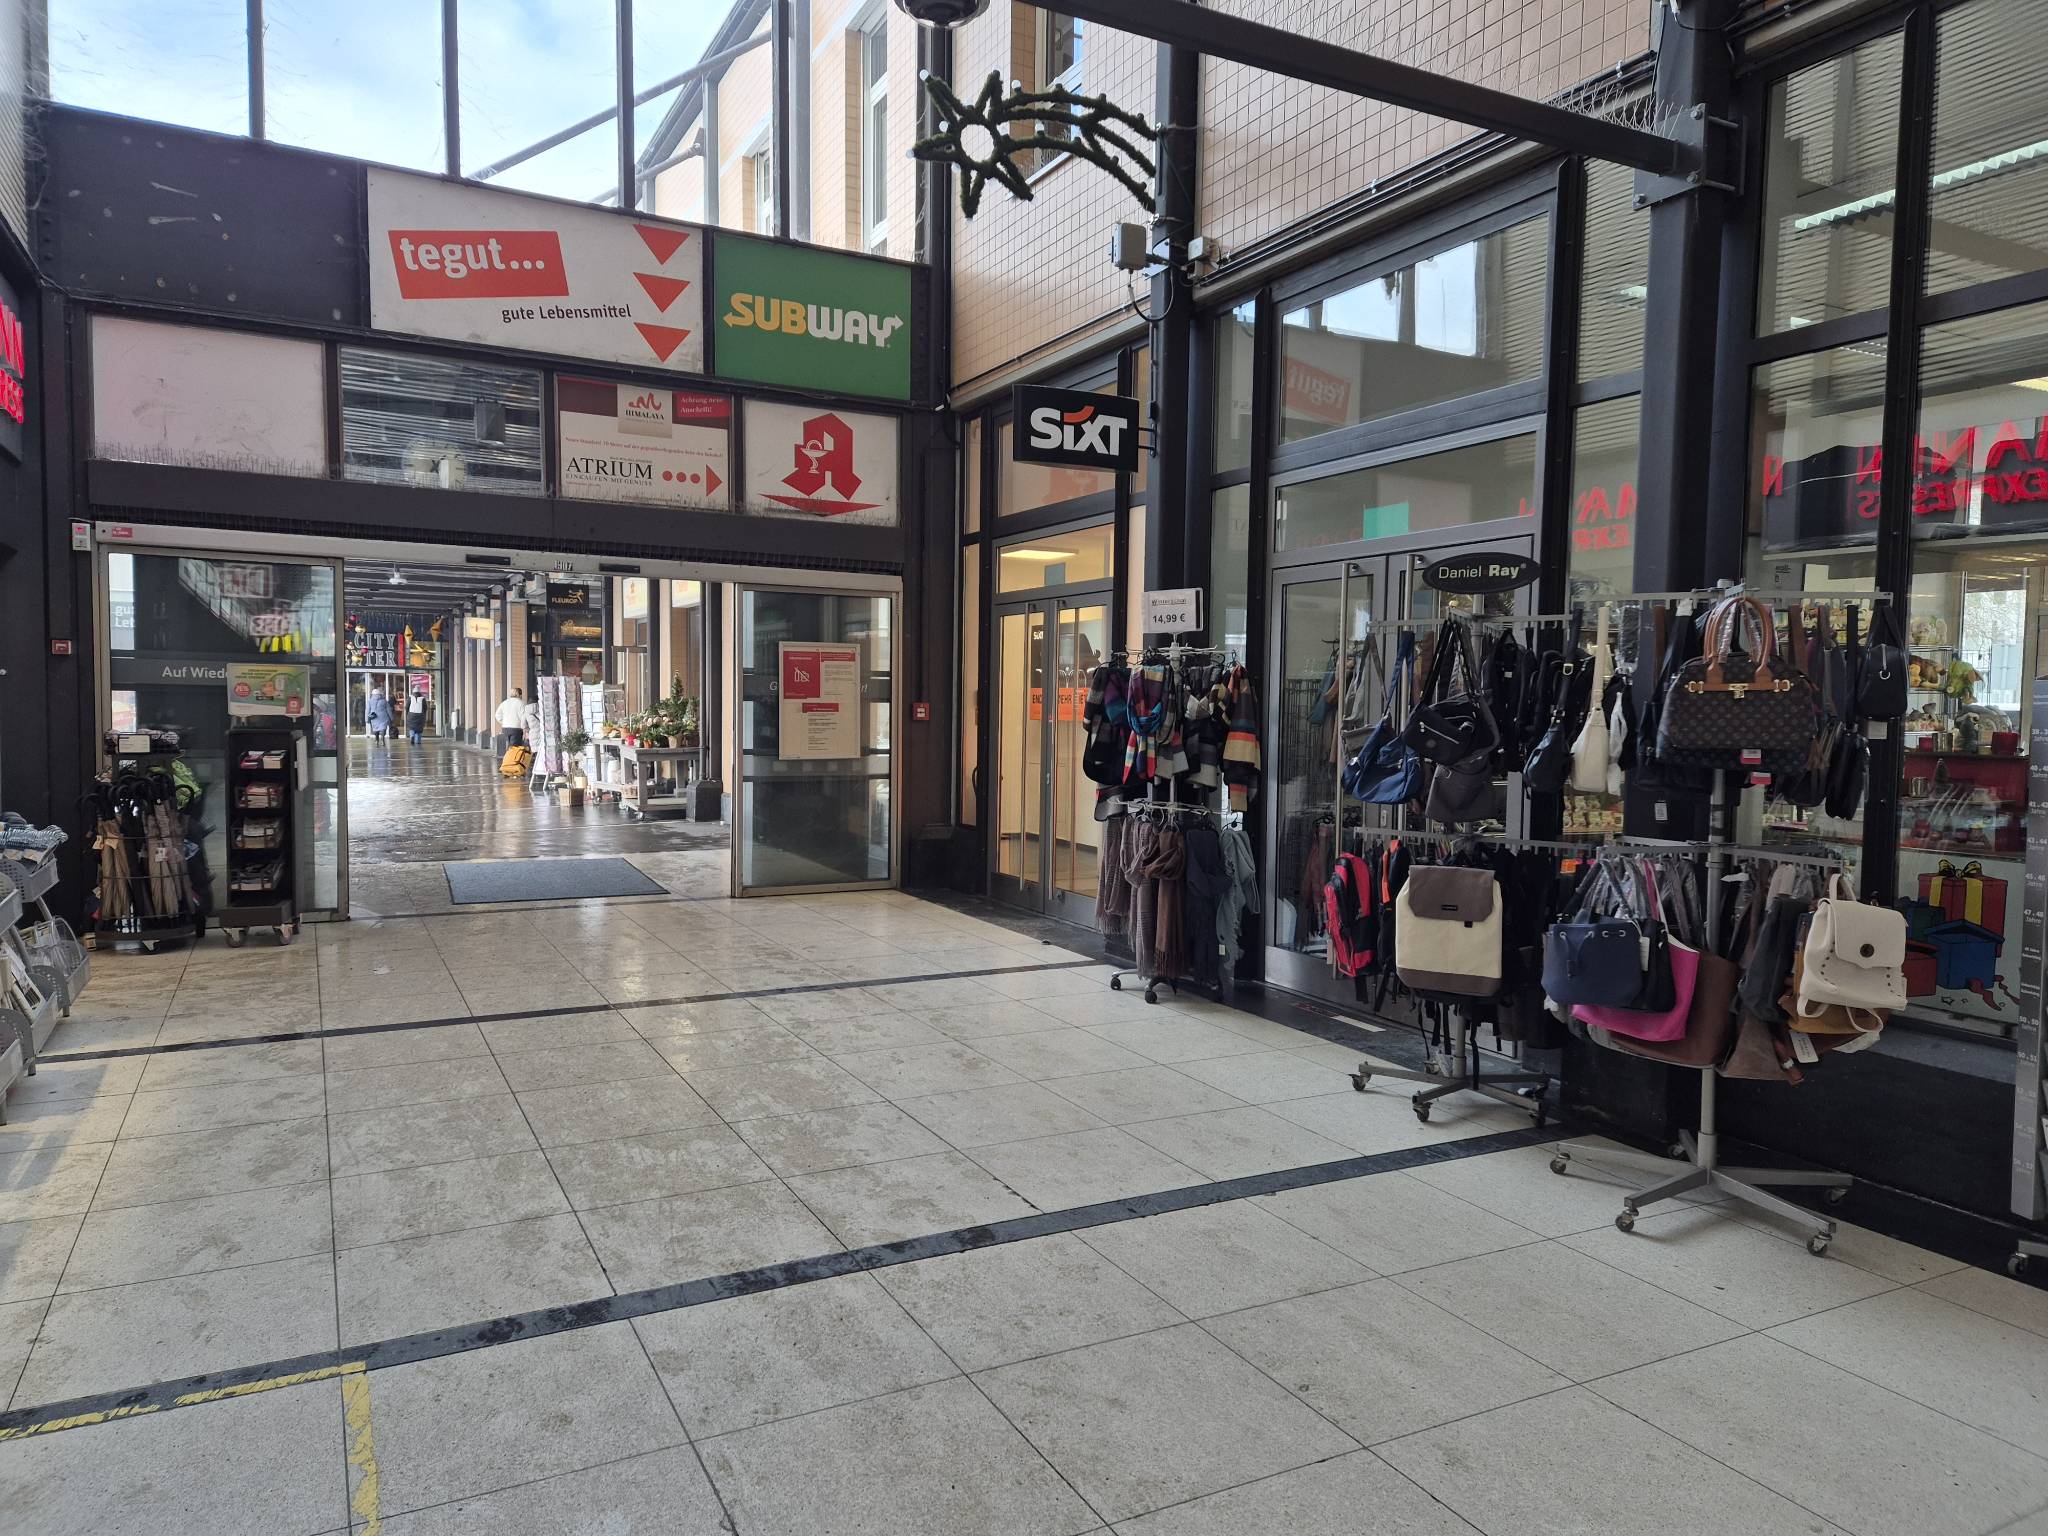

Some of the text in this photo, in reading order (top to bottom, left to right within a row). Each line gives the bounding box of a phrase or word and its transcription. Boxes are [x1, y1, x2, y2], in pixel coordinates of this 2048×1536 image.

[501, 304, 632, 323] gute Lebensmittel
[723, 292, 904, 348] SUBWAY
[1029, 405, 1128, 456] SIXT
[566, 457, 653, 480] ATRIUM
[1438, 564, 1482, 579] Daniel
[1152, 613, 1186, 624] 14,99 €
[353, 632, 397, 650] CITY
[162, 665, 187, 678] Auf
[190, 666, 229, 679] Wied
